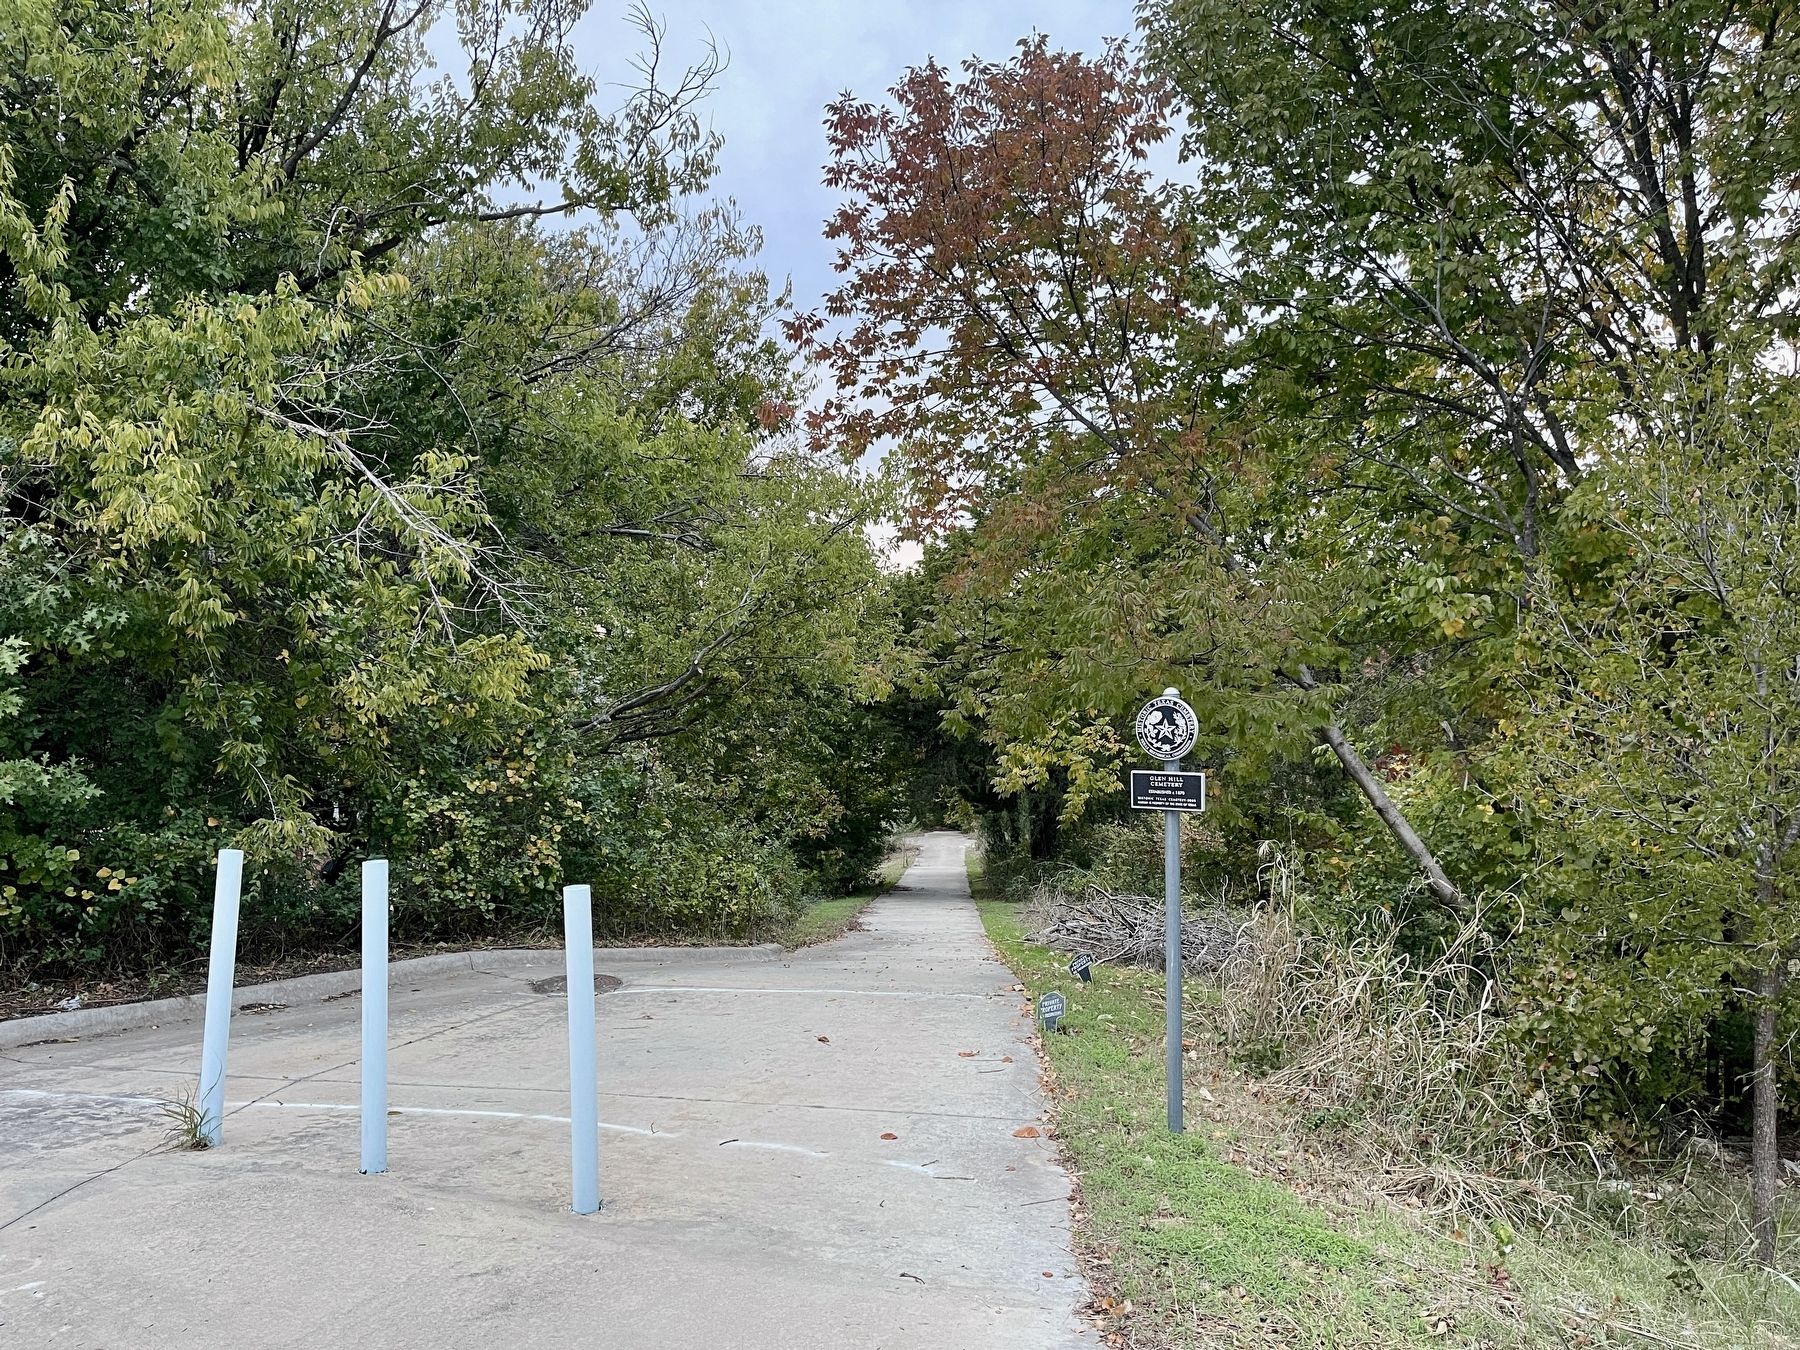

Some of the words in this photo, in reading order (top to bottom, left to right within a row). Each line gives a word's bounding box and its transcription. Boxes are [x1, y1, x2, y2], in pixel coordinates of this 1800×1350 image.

[1176, 703, 1195, 734] CEMETERY
[1041, 998, 1060, 1007] PRIVATE
[1040, 1003, 1063, 1013] ROPERTY
